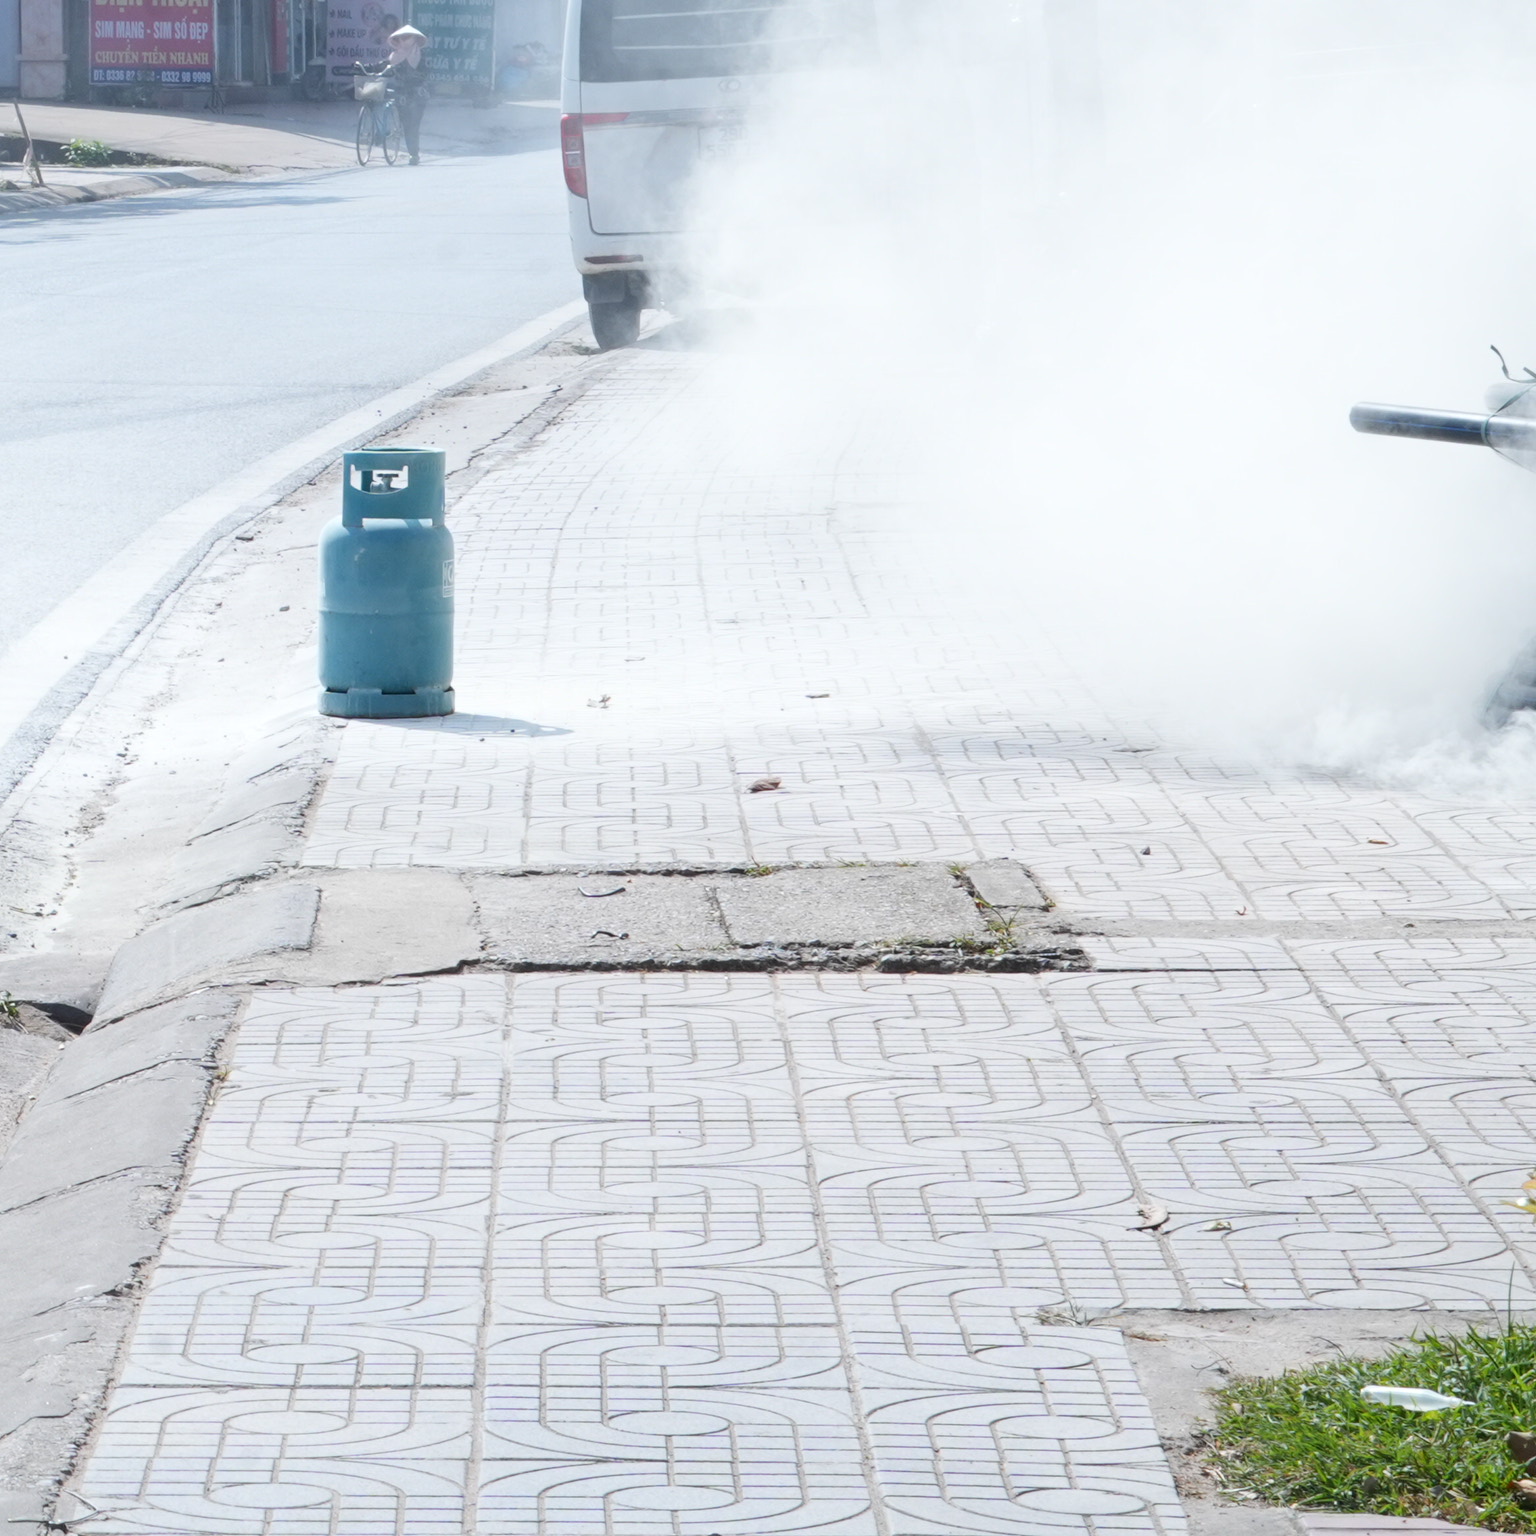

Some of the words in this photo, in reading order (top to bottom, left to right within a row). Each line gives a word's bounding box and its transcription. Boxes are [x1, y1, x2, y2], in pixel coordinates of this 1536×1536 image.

[337, 9, 352, 20] NAIL
[95, 20, 114, 39] SIM
[116, 20, 144, 42] MẠNG
[153, 21, 172, 39] SIM
[175, 16, 187, 40] SỐ
[189, 22, 209, 44] ĐẸP
[336, 28, 356, 39] MAKE
[95, 44, 139, 64] CHUYỂN
[170, 51, 209, 65] NHANH
